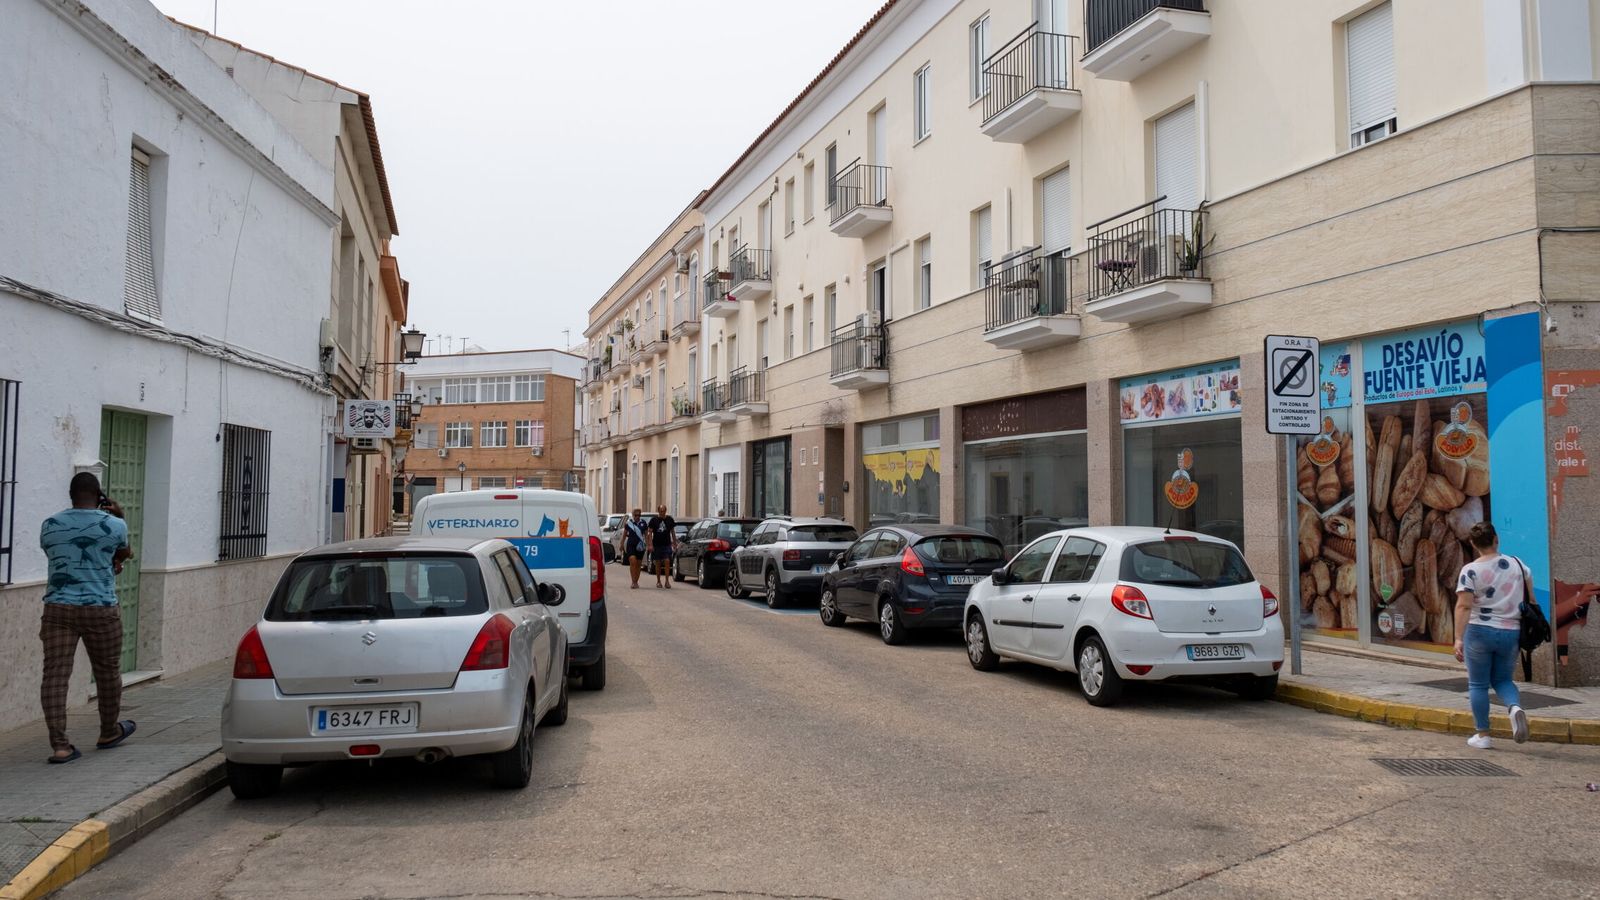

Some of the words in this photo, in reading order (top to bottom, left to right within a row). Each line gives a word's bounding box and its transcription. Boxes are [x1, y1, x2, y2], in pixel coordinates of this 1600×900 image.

[1382, 329, 1464, 369] DESAVÍO
[1363, 363, 1425, 395] FUENTE
[1429, 355, 1488, 387] VIEJA
[1364, 393, 1388, 402] Productos
[1415, 388, 1423, 396] del
[429, 518, 519, 529] VETERINARIO
[524, 545, 538, 557] 79
[1194, 645, 1219, 657] 9683
[1222, 645, 1241, 657] GZR
[330, 711, 373, 728] 6347
[379, 709, 411, 726] FRJ
